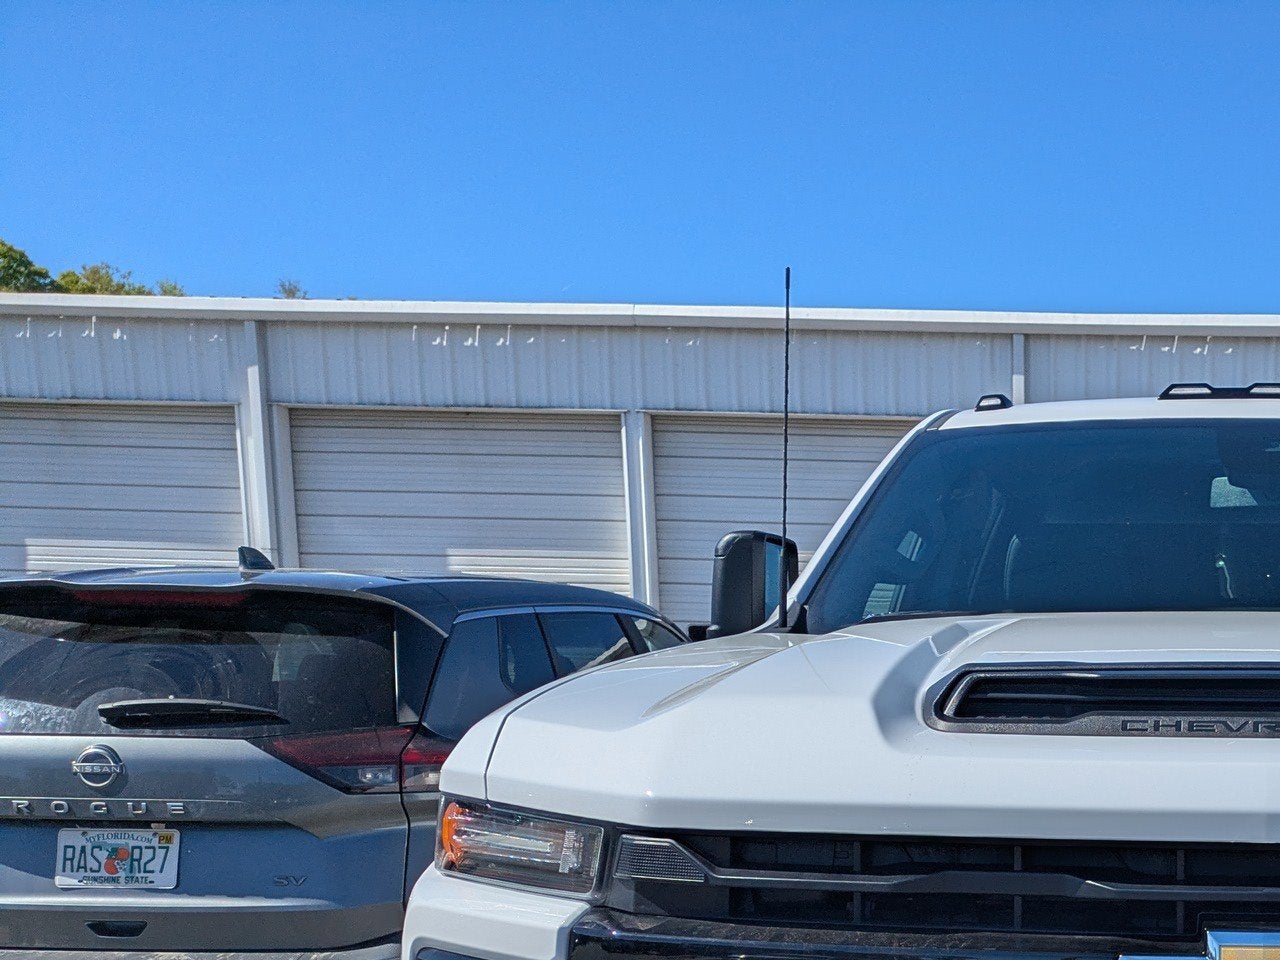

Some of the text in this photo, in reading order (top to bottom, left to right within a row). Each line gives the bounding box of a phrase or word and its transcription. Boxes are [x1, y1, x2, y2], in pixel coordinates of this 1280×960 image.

[73, 765, 120, 773] NISSAN
[12, 800, 185, 814] ROGUE
[61, 845, 170, 874] RAS R27
[82, 875, 150, 885] SUNSHINE STATE
